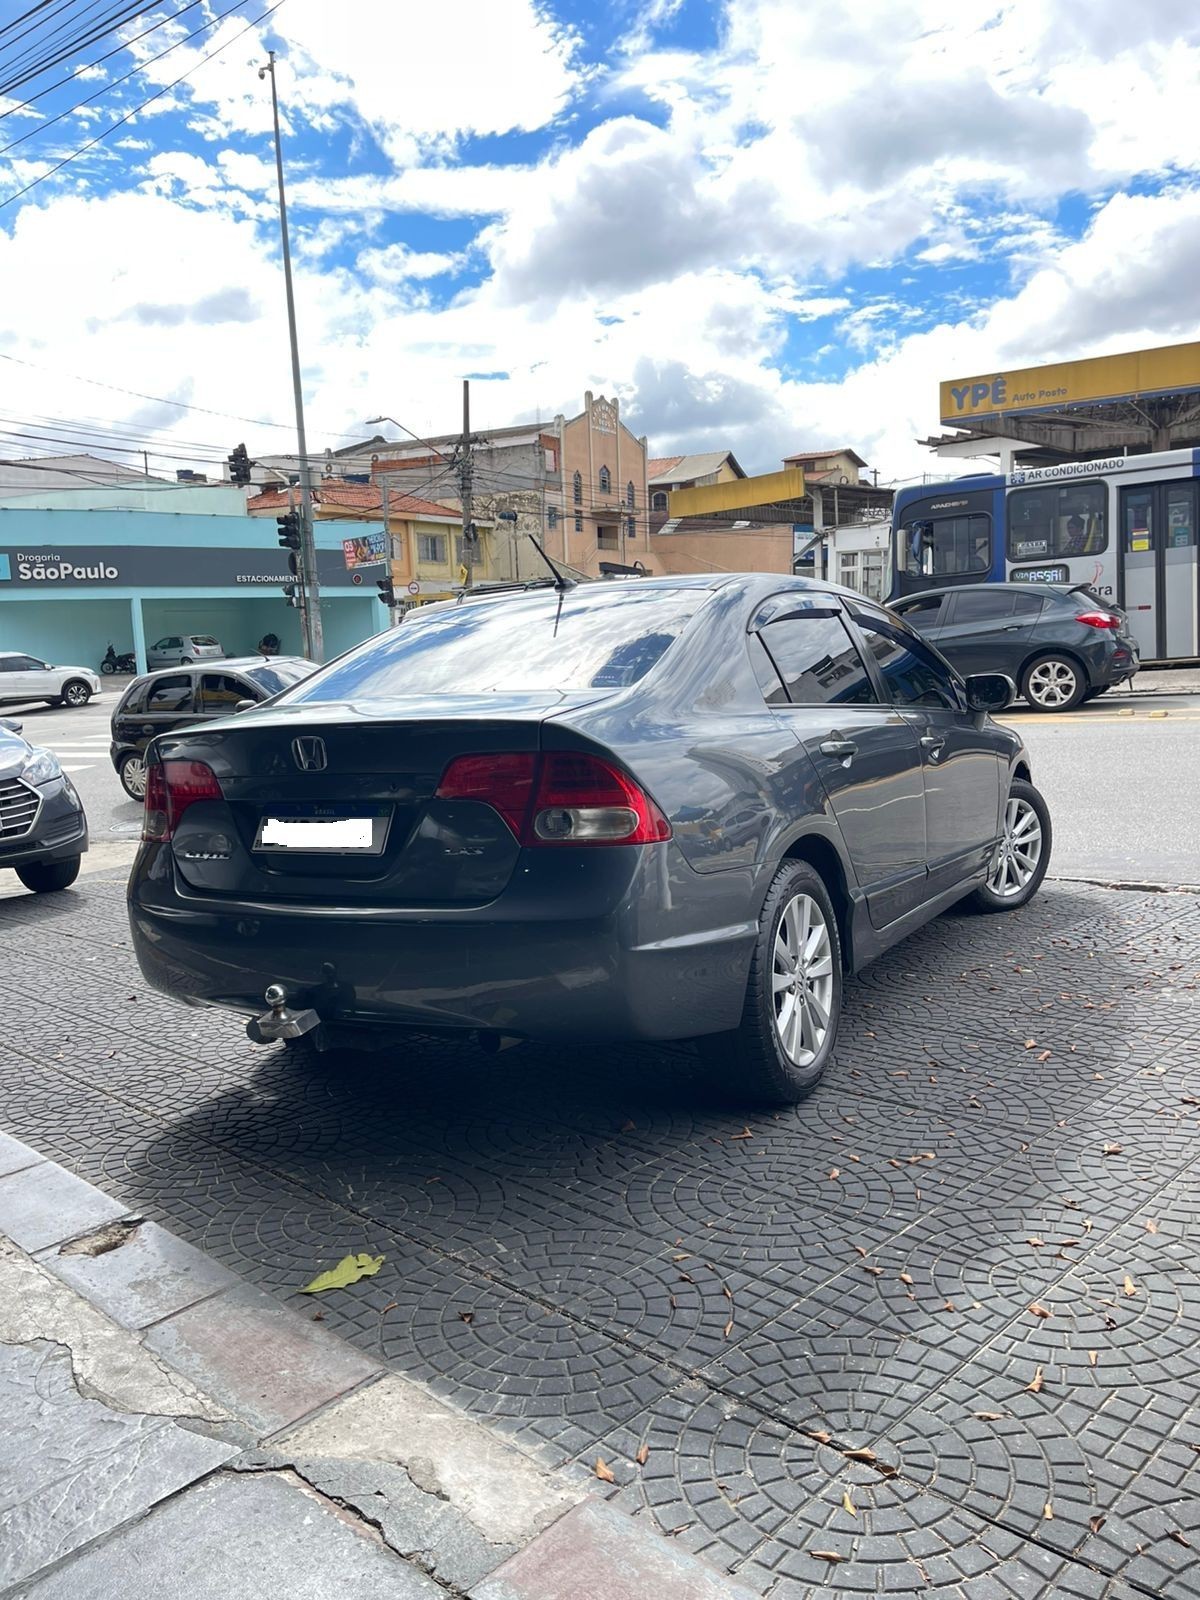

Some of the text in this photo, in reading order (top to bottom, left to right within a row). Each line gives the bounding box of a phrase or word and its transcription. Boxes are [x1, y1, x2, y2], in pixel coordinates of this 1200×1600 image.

[951, 376, 1068, 410] YPÊ Auto Posto
[1028, 458, 1125, 480] AR CONDICIONADO
[17, 553, 60, 563] Drogaria
[236, 574, 299, 583] ESTACIONAMENT
